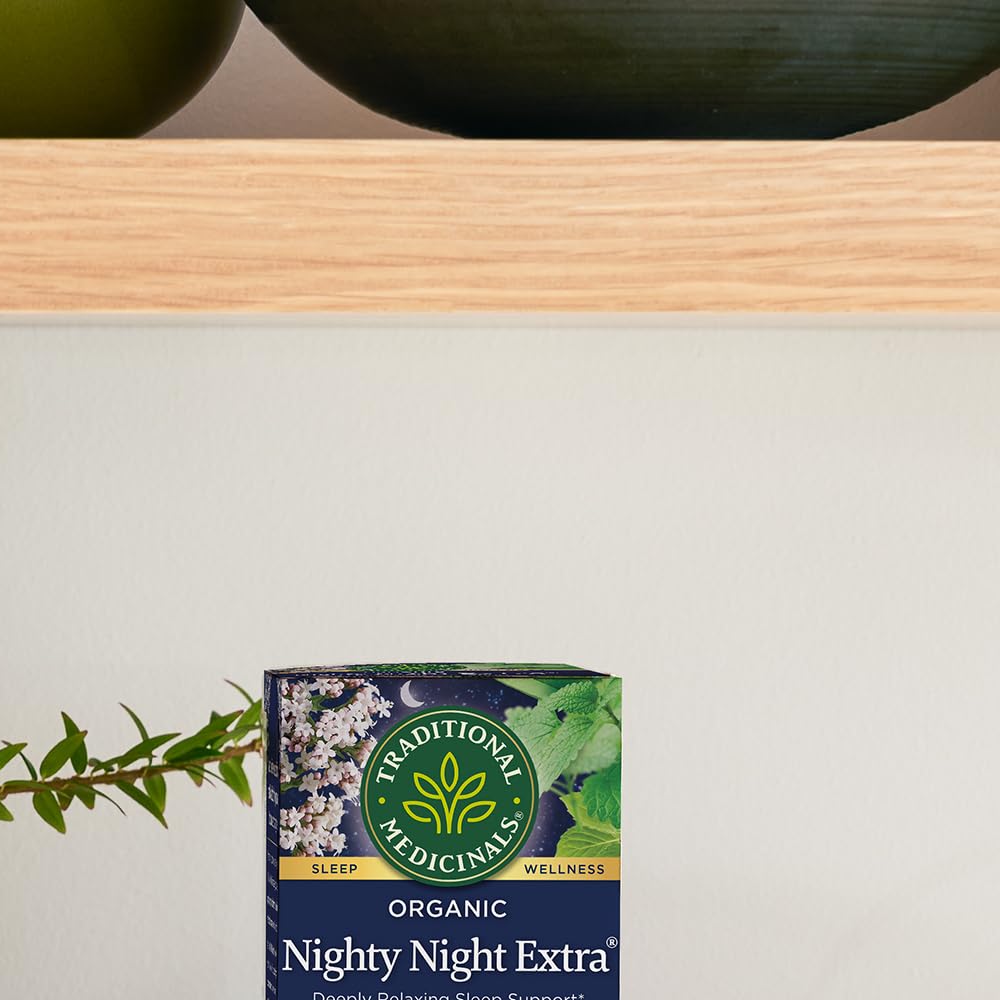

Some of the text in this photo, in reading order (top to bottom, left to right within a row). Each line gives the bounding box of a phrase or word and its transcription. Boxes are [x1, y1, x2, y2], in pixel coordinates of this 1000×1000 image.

[376, 720, 522, 785] TRADITIONAL
[312, 863, 357, 874] SLEEP
[524, 864, 605, 875] WELLNESS
[388, 899, 507, 918] ORGANIC
[283, 936, 402, 982] Nighty
[410, 937, 507, 982] Night
